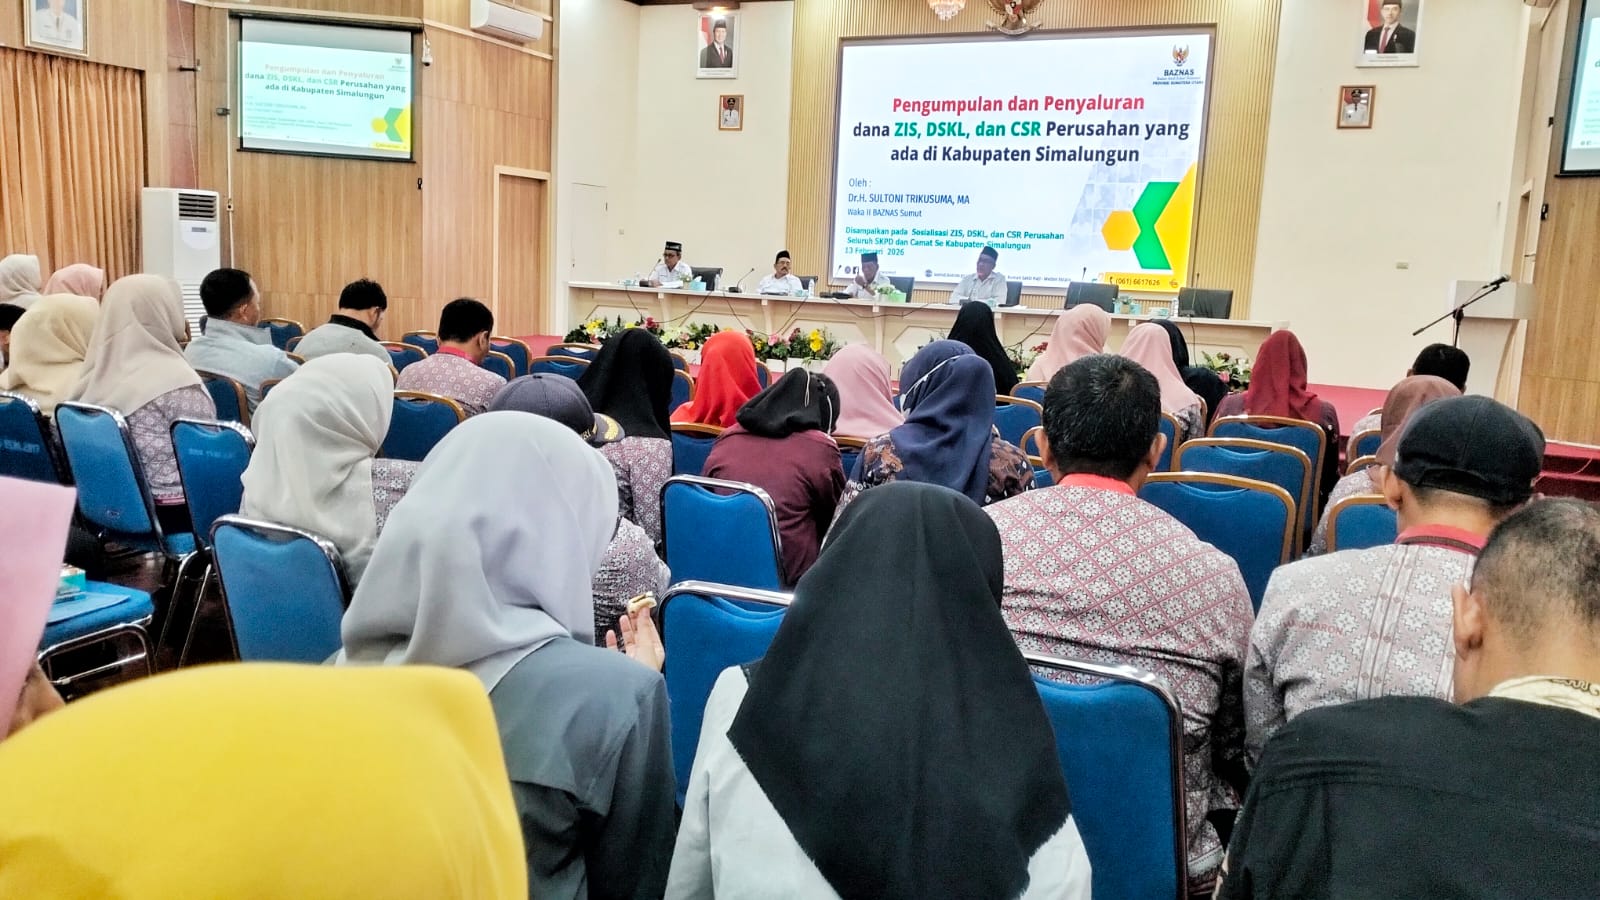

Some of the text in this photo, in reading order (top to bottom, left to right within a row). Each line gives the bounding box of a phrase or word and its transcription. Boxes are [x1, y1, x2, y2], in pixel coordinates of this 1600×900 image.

[244, 72, 264, 80] dana
[306, 76, 322, 84] dan
[340, 80, 384, 90] Perusahan
[385, 84, 406, 93] yang
[291, 85, 335, 95] Kabupaten
[336, 88, 385, 100] Simalungun
[893, 94, 1145, 117] Pengumpulan dan Penyaluran
[853, 120, 1190, 140] dana ZIS, DSKL, dan CSR Perusahan yang
[890, 145, 1140, 167] ada di Kabupaten Simalungun
[848, 178, 867, 188] Oleh
[848, 193, 970, 206] Dr.H. SULTONI TRIKUSUMA, MA
[847, 208, 865, 216] Waka
[872, 208, 899, 217] BAZNAS
[900, 209, 922, 217] Sumut
[845, 226, 1065, 240] Disampaikan pada Sosialisasi ZIS, DSKL, dan CSR Perusahan
[847, 237, 1032, 250] Seluruh SKPD dan Camat Se Kabupaten Simalungun
[887, 248, 905, 256] 2026
[1116, 278, 1132, 286] (061)
